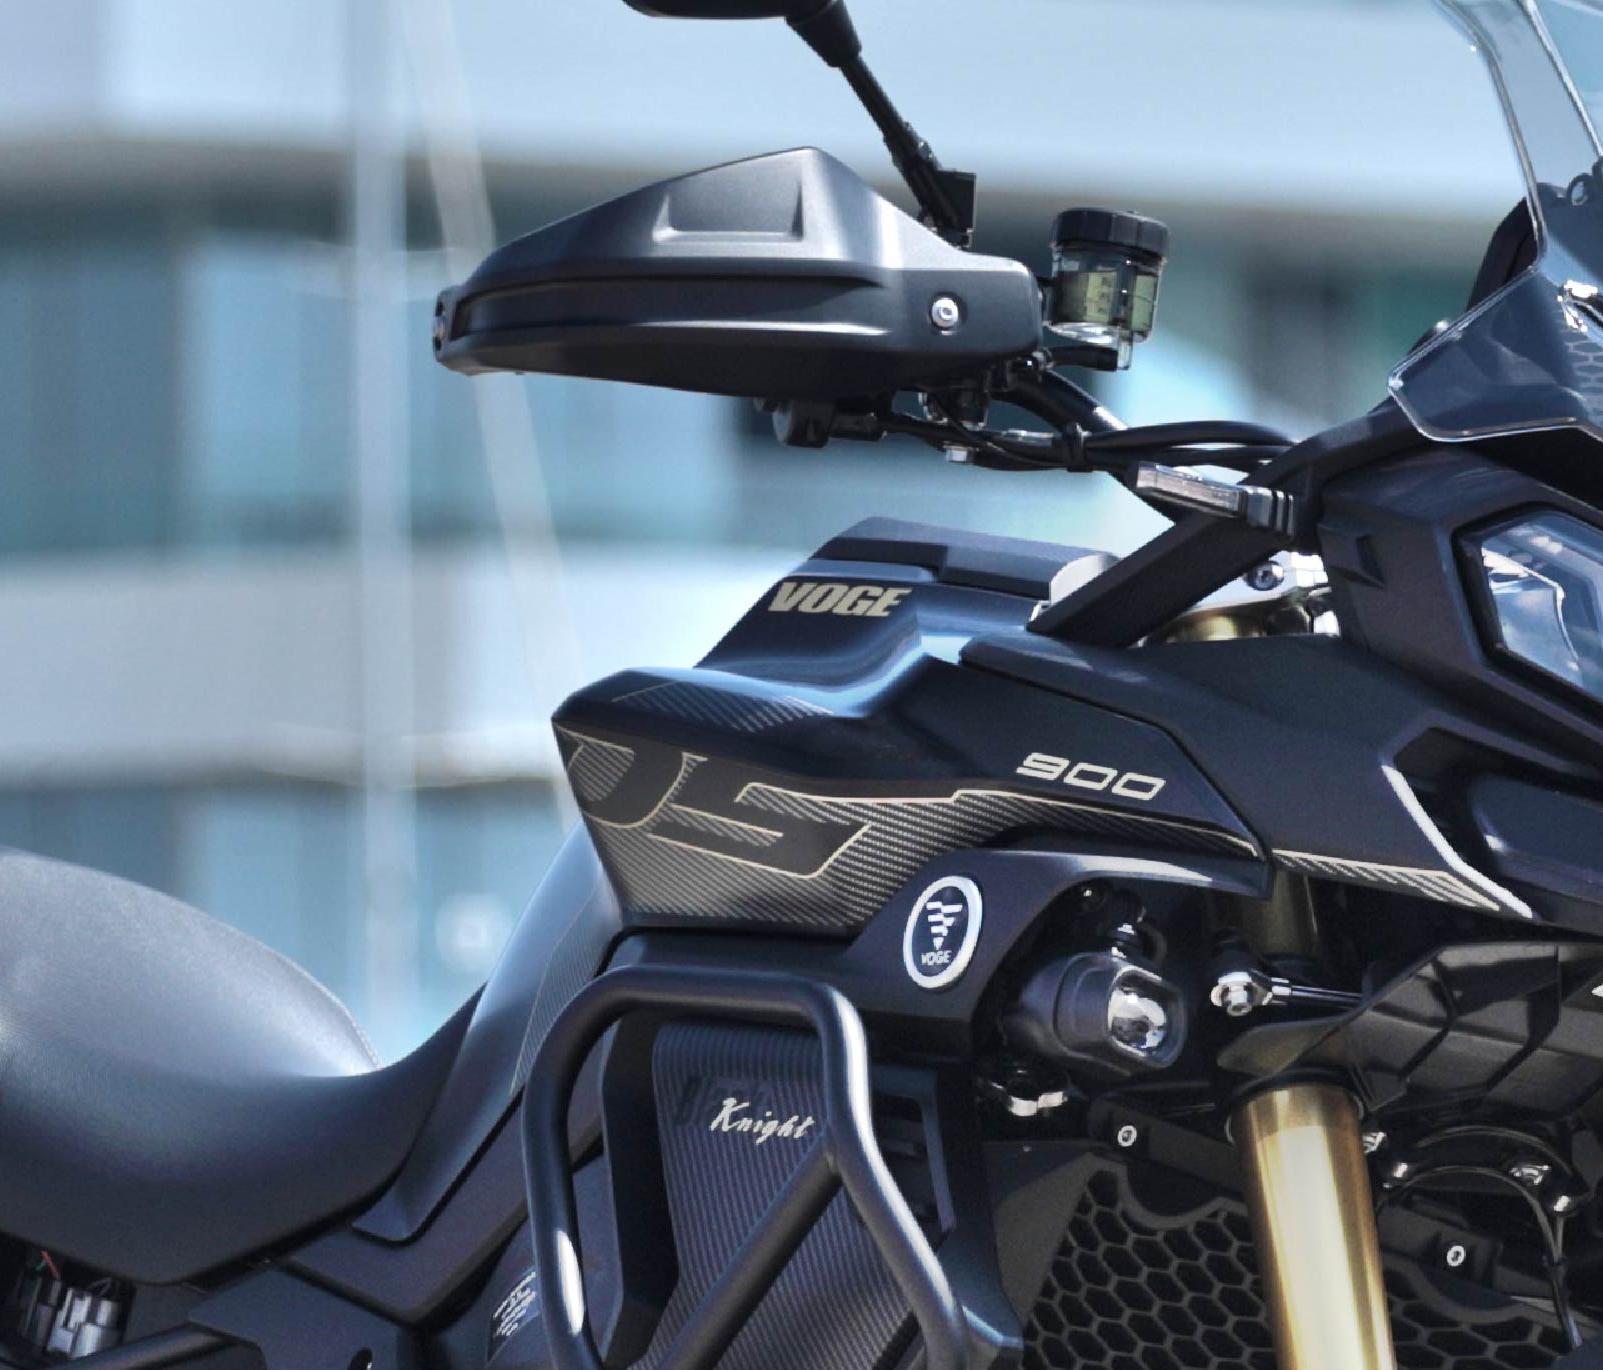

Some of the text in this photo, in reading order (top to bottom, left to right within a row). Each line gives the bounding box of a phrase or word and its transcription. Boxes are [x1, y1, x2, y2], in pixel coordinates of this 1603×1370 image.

[768, 581, 913, 617] VOGE
[1016, 752, 1167, 801] 900
[920, 950, 953, 966] VOGE
[710, 1097, 815, 1144] Knight
